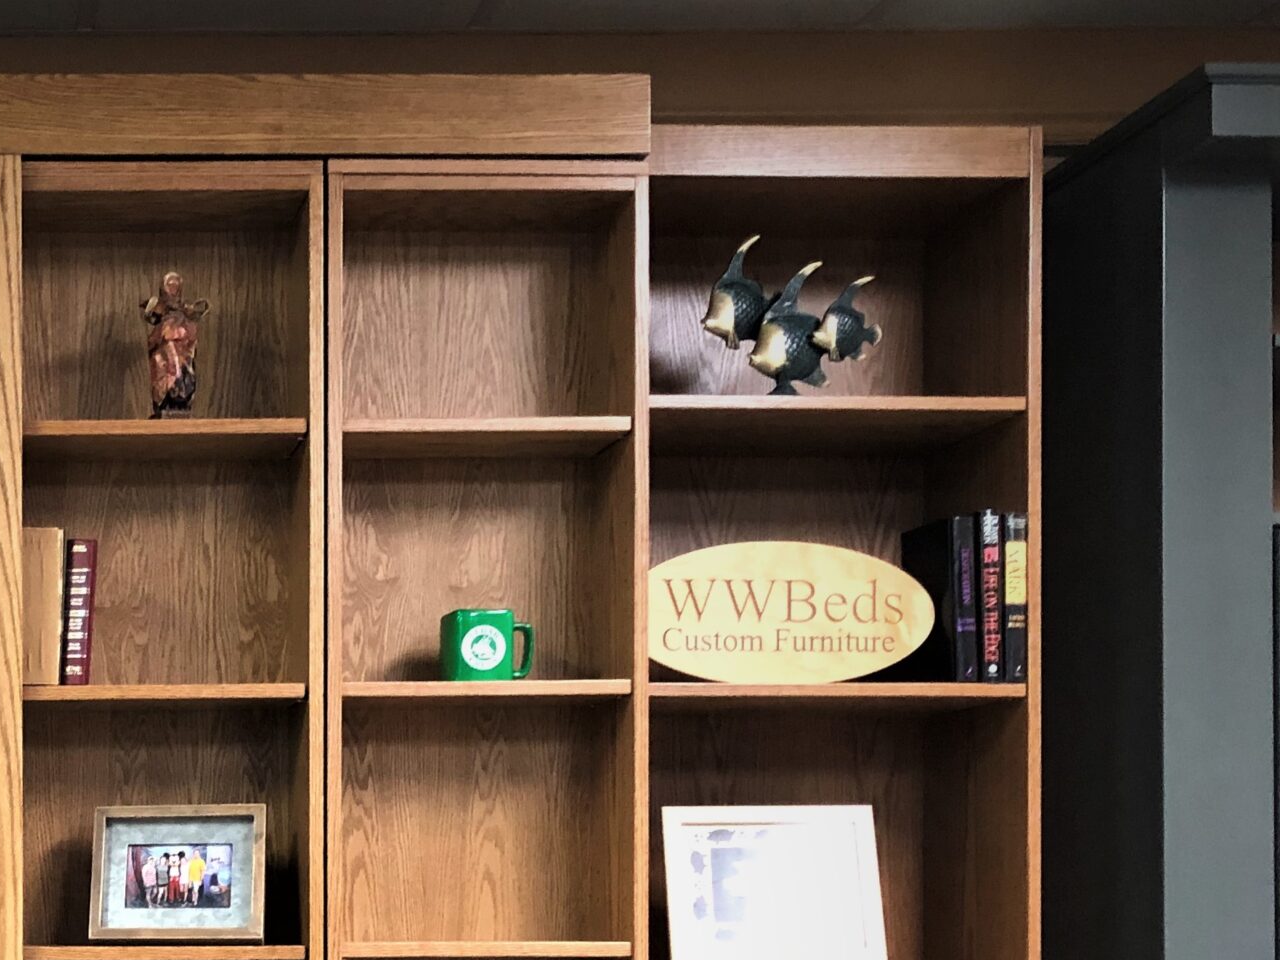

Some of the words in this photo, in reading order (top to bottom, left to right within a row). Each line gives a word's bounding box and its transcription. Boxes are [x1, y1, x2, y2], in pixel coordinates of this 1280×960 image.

[662, 578, 904, 625] WWBeds
[984, 591, 997, 608] ON
[983, 610, 999, 631] THE
[662, 628, 763, 653] Custom
[774, 627, 896, 654] Furniture
[983, 633, 1001, 662] EDGE
